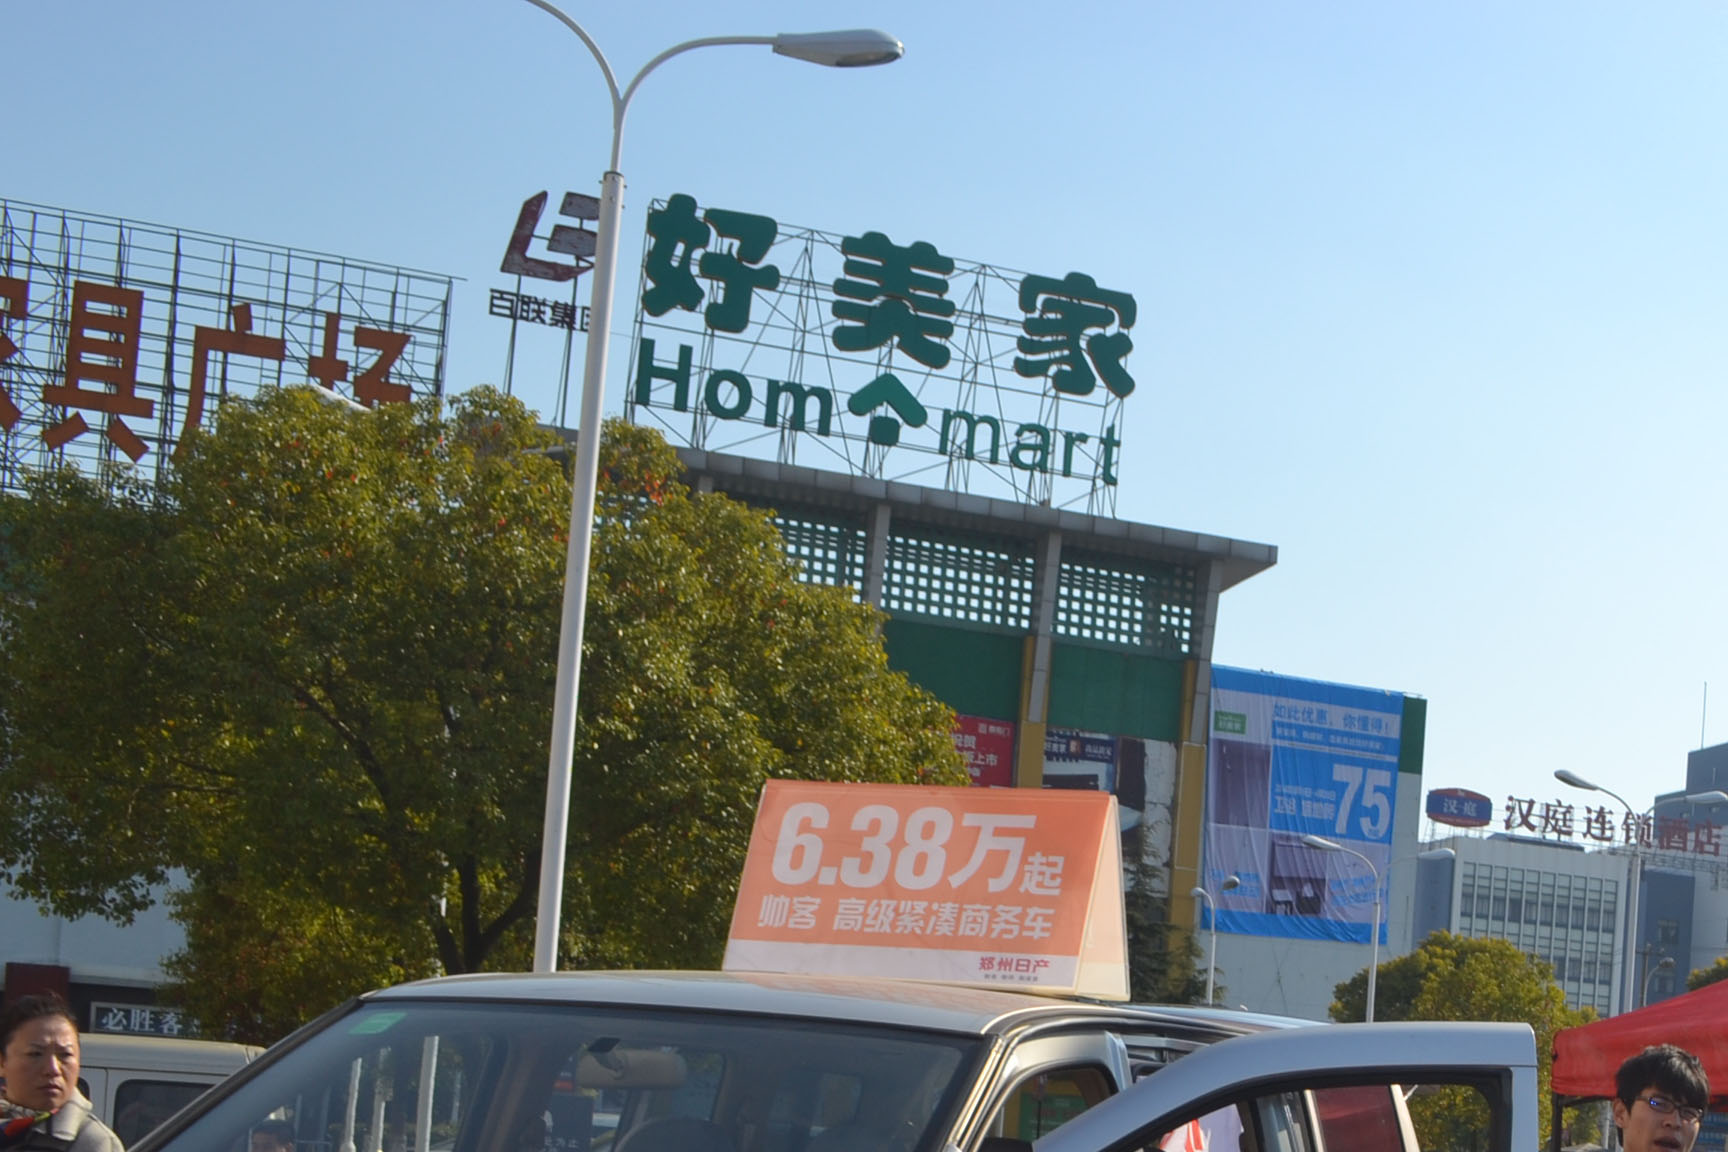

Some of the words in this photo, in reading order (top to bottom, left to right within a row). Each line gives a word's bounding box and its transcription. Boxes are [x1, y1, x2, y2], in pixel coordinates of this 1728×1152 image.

[641, 193, 1137, 398] 好美家
[0, 276, 412, 463] 具广场
[1333, 764, 1391, 839] 75
[1505, 795, 1723, 857] 汉庭连锁酒店
[772, 802, 1064, 896] 6.38万起
[757, 895, 821, 929] 帅客
[833, 897, 1055, 940] 高级紧凑商务车
[979, 956, 1050, 973] 郑州日产
